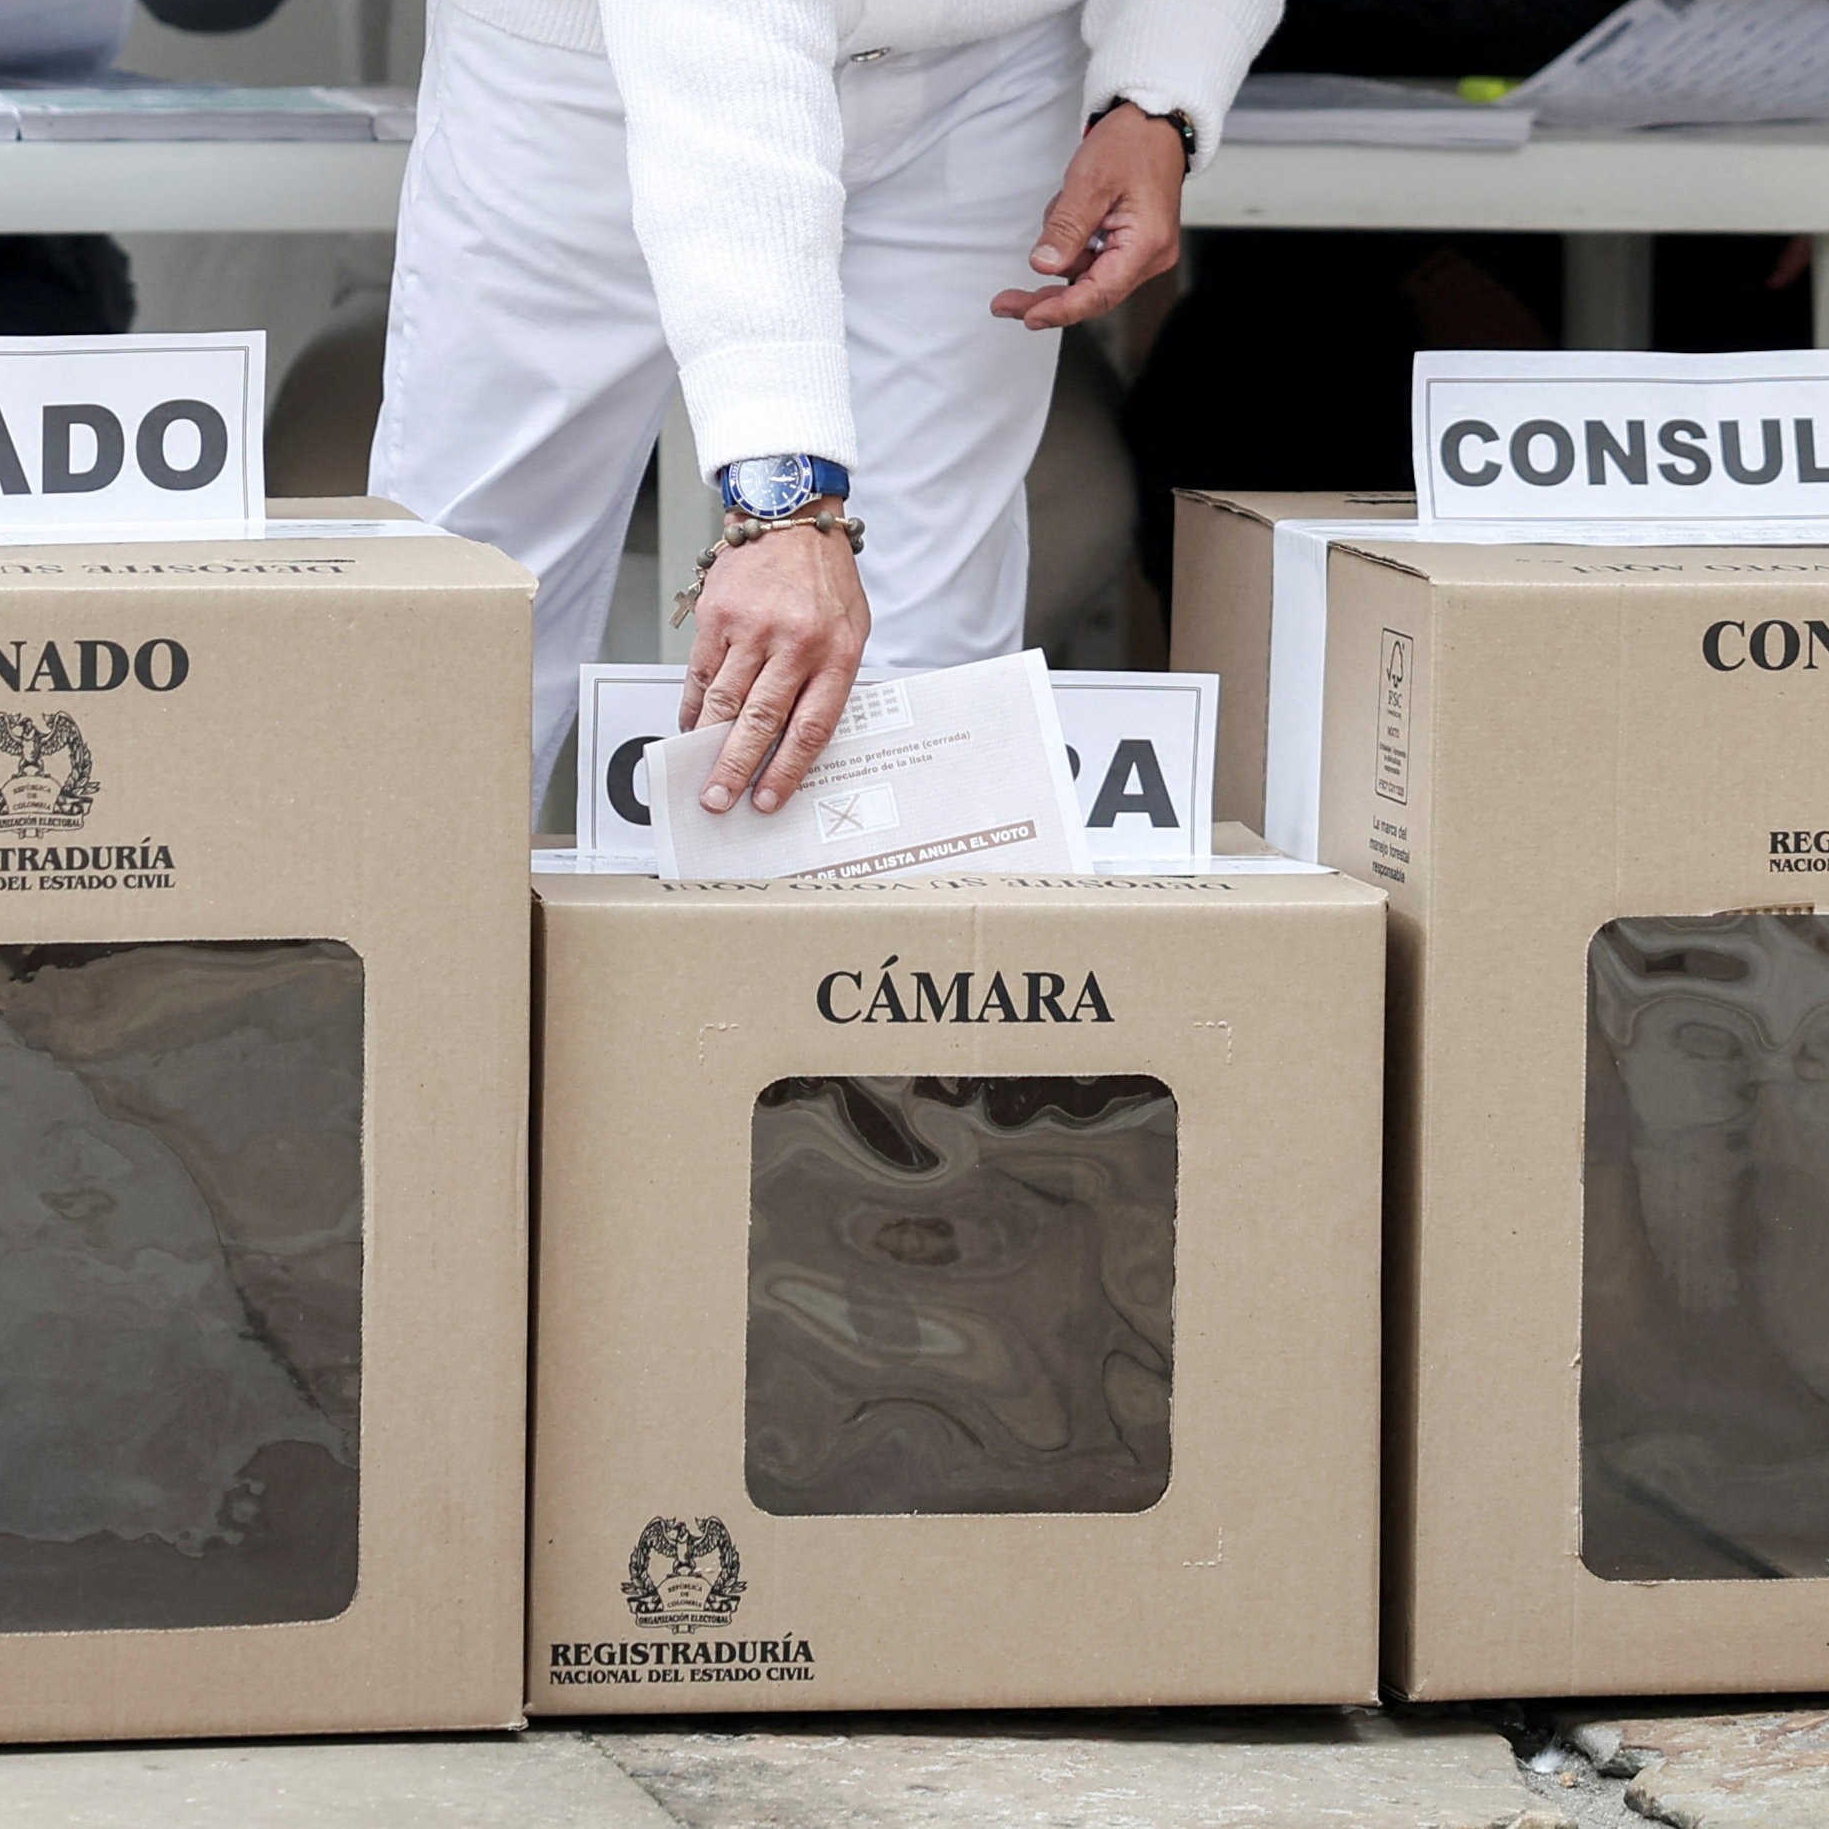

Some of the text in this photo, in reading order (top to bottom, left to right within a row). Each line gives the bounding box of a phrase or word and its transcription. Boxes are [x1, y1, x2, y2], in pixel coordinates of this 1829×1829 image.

[0, 565, 65, 575] SU
[81, 564, 346, 574] DEPOSITE
[807, 730, 971, 775] on voto no preferente (cerrada)
[796, 753, 933, 792] que el recuadro de la lista
[39, 817, 81, 827] ELECTORAL
[839, 861, 872, 878] UNA
[874, 852, 916, 871] LISTA
[918, 840, 968, 861] ANULA
[970, 836, 988, 849] EL
[990, 826, 1029, 843] VOTO
[39, 874, 117, 890] ESTADO
[123, 873, 176, 889] CIVIL
[789, 882, 917, 892] VOTO
[928, 877, 988, 890] SU
[999, 877, 1237, 892] DEPOSITE
[816, 954, 1115, 1024] CÁMARA
[691, 1615, 729, 1623] ELECTORAL
[549, 1632, 815, 1667] REGISTRADURÍA
[549, 1667, 815, 1685] NACIONAL DEL ESTADO CIVIL
